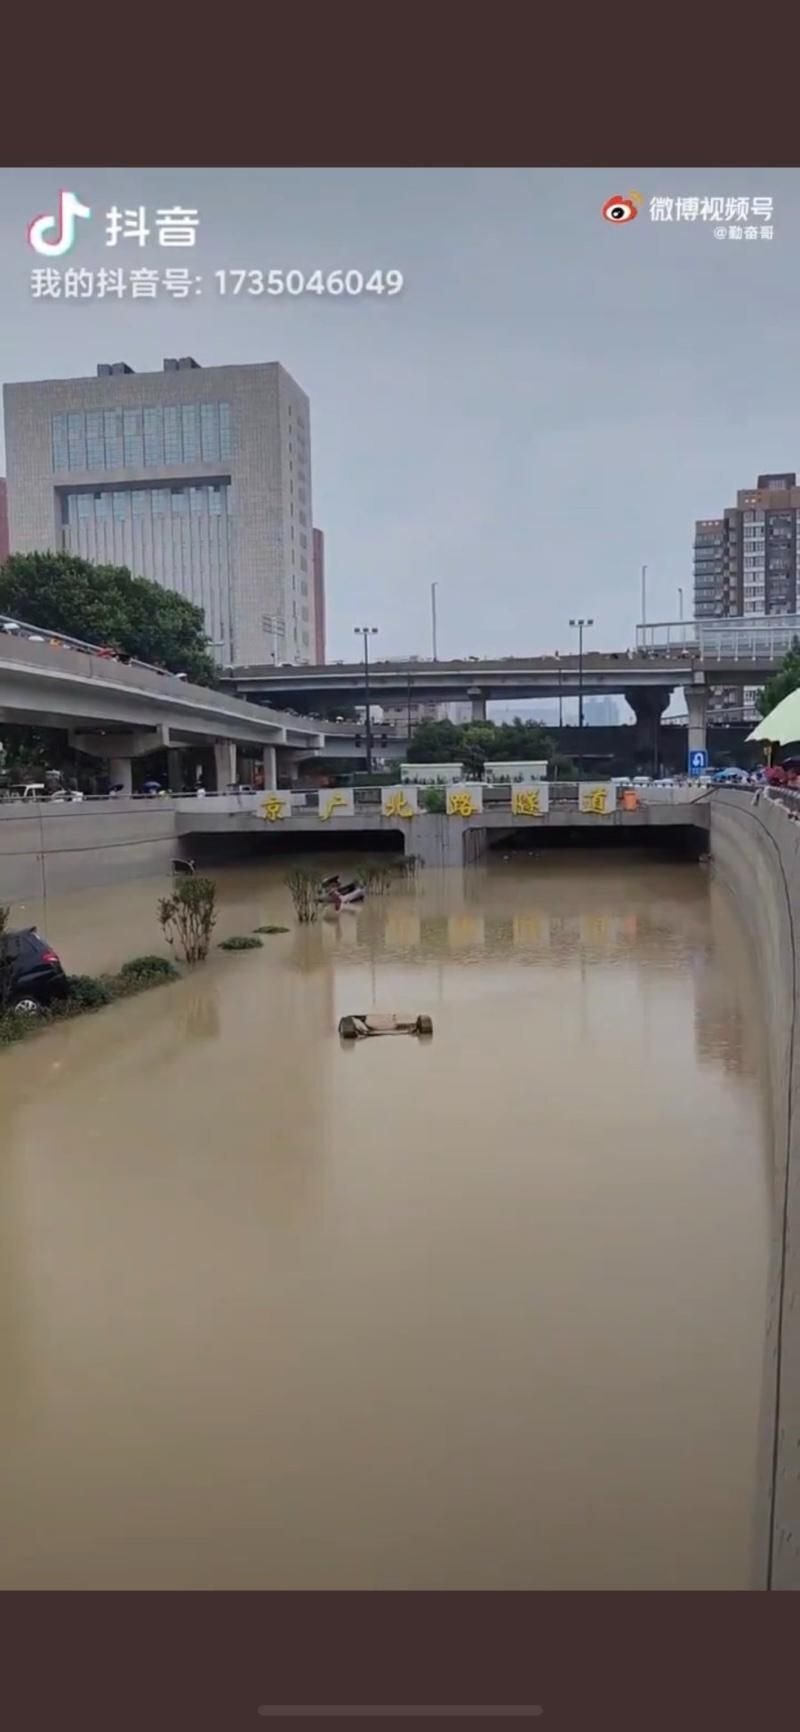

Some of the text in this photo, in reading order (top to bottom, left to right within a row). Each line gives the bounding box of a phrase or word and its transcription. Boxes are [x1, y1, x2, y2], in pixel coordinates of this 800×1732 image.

[260, 788, 609, 822] 京广北路隧道
